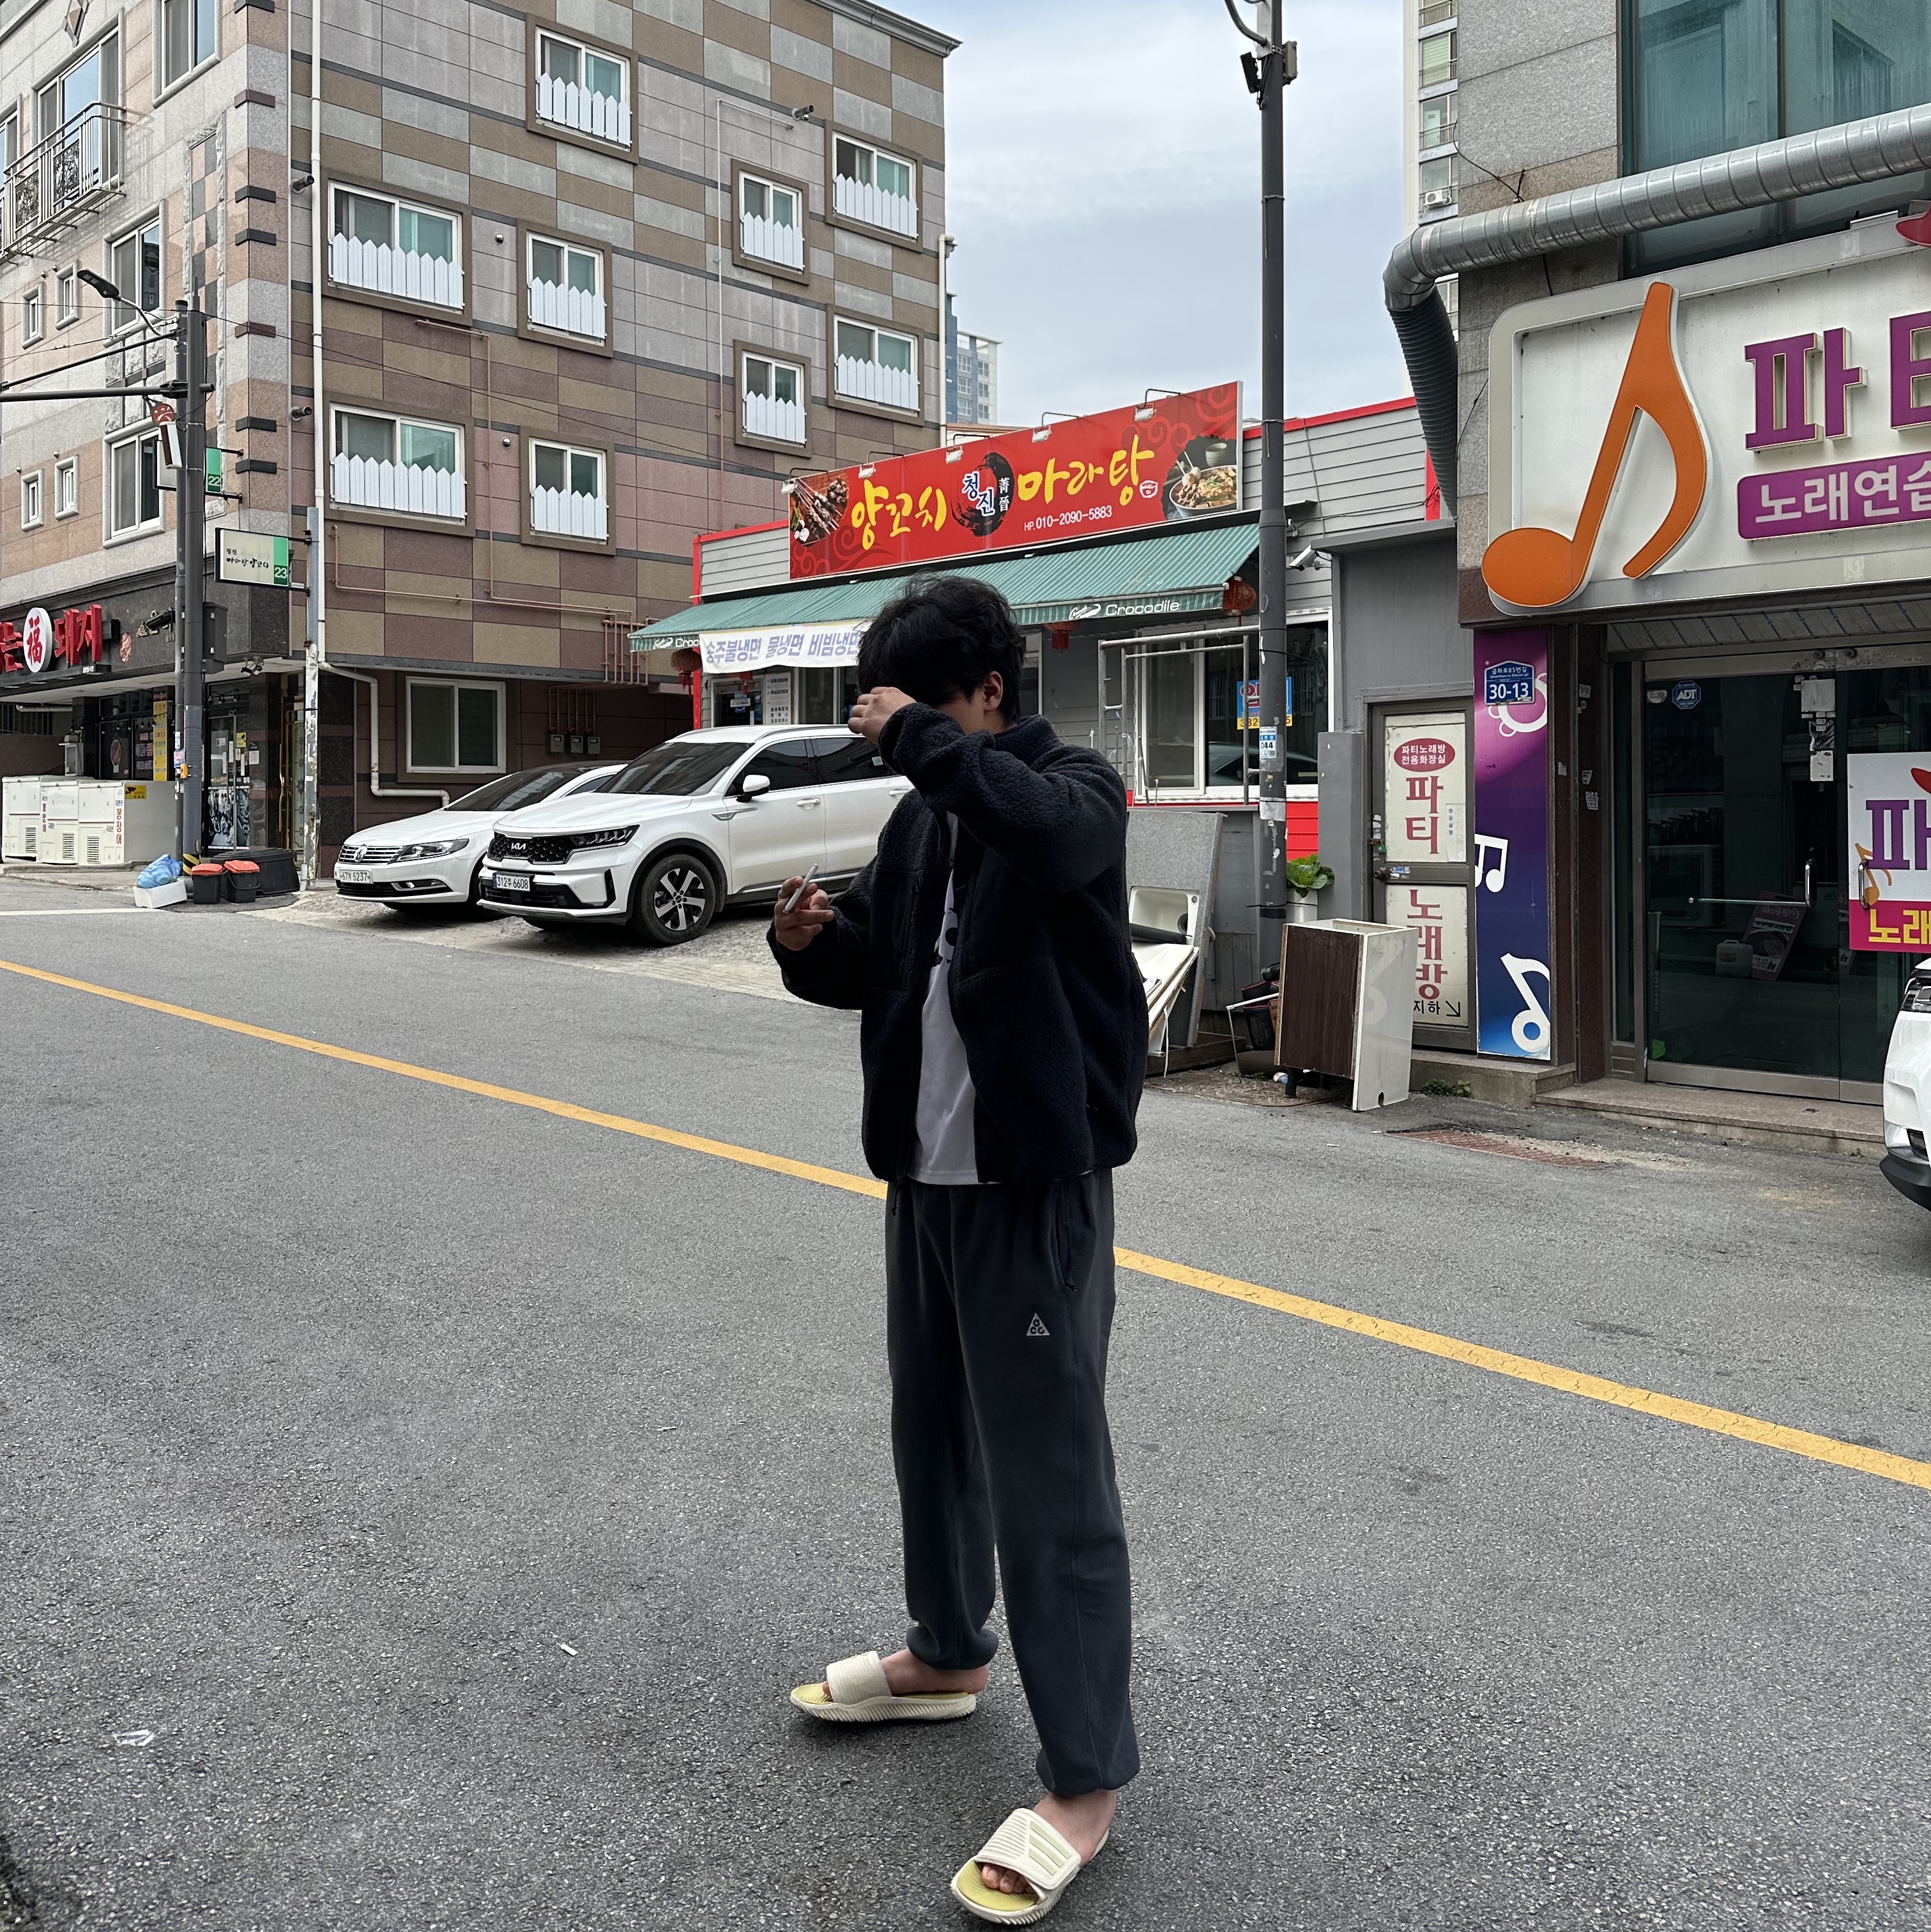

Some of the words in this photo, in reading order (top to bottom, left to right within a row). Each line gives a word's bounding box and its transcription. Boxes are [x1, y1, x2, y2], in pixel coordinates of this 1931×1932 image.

[1018, 434, 1154, 506] 마라탕
[208, 475, 220, 487] 22
[963, 471, 995, 516] 청진
[1036, 506, 1113, 531] 010-2090-5883
[275, 567, 288, 579] 23
[1106, 600, 1180, 616] Crocodile
[54, 604, 102, 666] 돼지
[706, 637, 762, 664] 송주불냉면
[765, 633, 805, 658] 물냉면
[807, 631, 860, 657] 비빔냉면
[1489, 682, 1529, 700] 30-13
[1676, 688, 1697, 701] ADT
[1401, 743, 1446, 754] 파티노래방
[1401, 754, 1446, 765] 전용화장실
[1405, 775, 1444, 854] 파티
[353, 872, 367, 881] 5237
[513, 878, 528, 890] 6608
[1868, 908, 1931, 945] 노래
[1406, 889, 1448, 1000] 노래방
[1413, 1000, 1440, 1015] 지하
